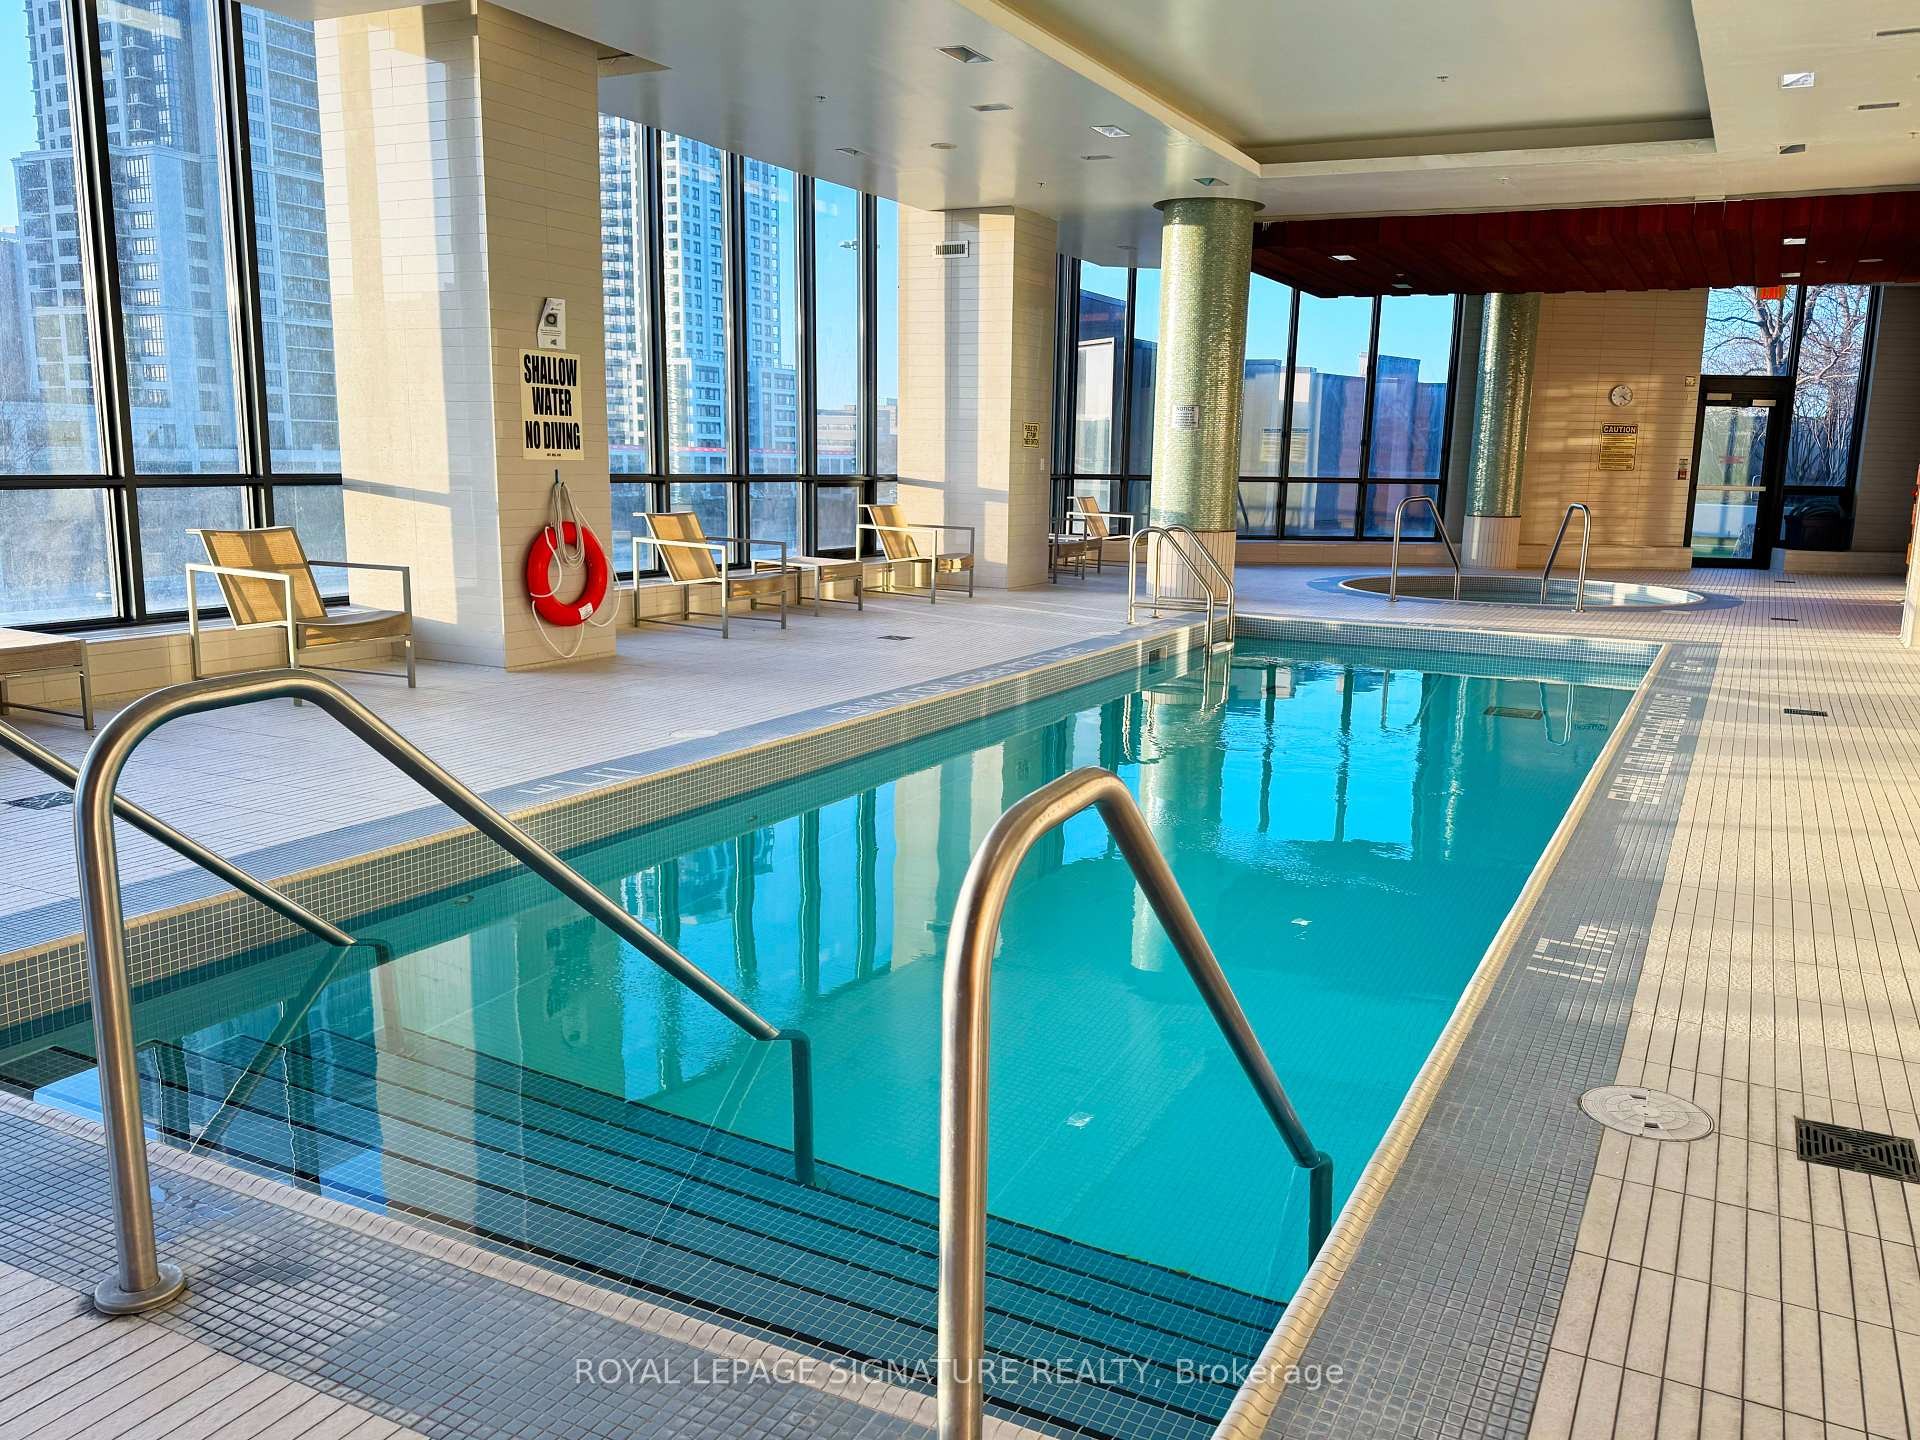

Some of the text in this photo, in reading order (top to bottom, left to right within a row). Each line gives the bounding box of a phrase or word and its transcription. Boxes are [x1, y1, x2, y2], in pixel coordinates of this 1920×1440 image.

[524, 354, 577, 386] SHALLOW
[532, 388, 572, 416] WATER
[525, 420, 580, 450] NO DIVING
[1603, 425, 1636, 433] CAUTION
